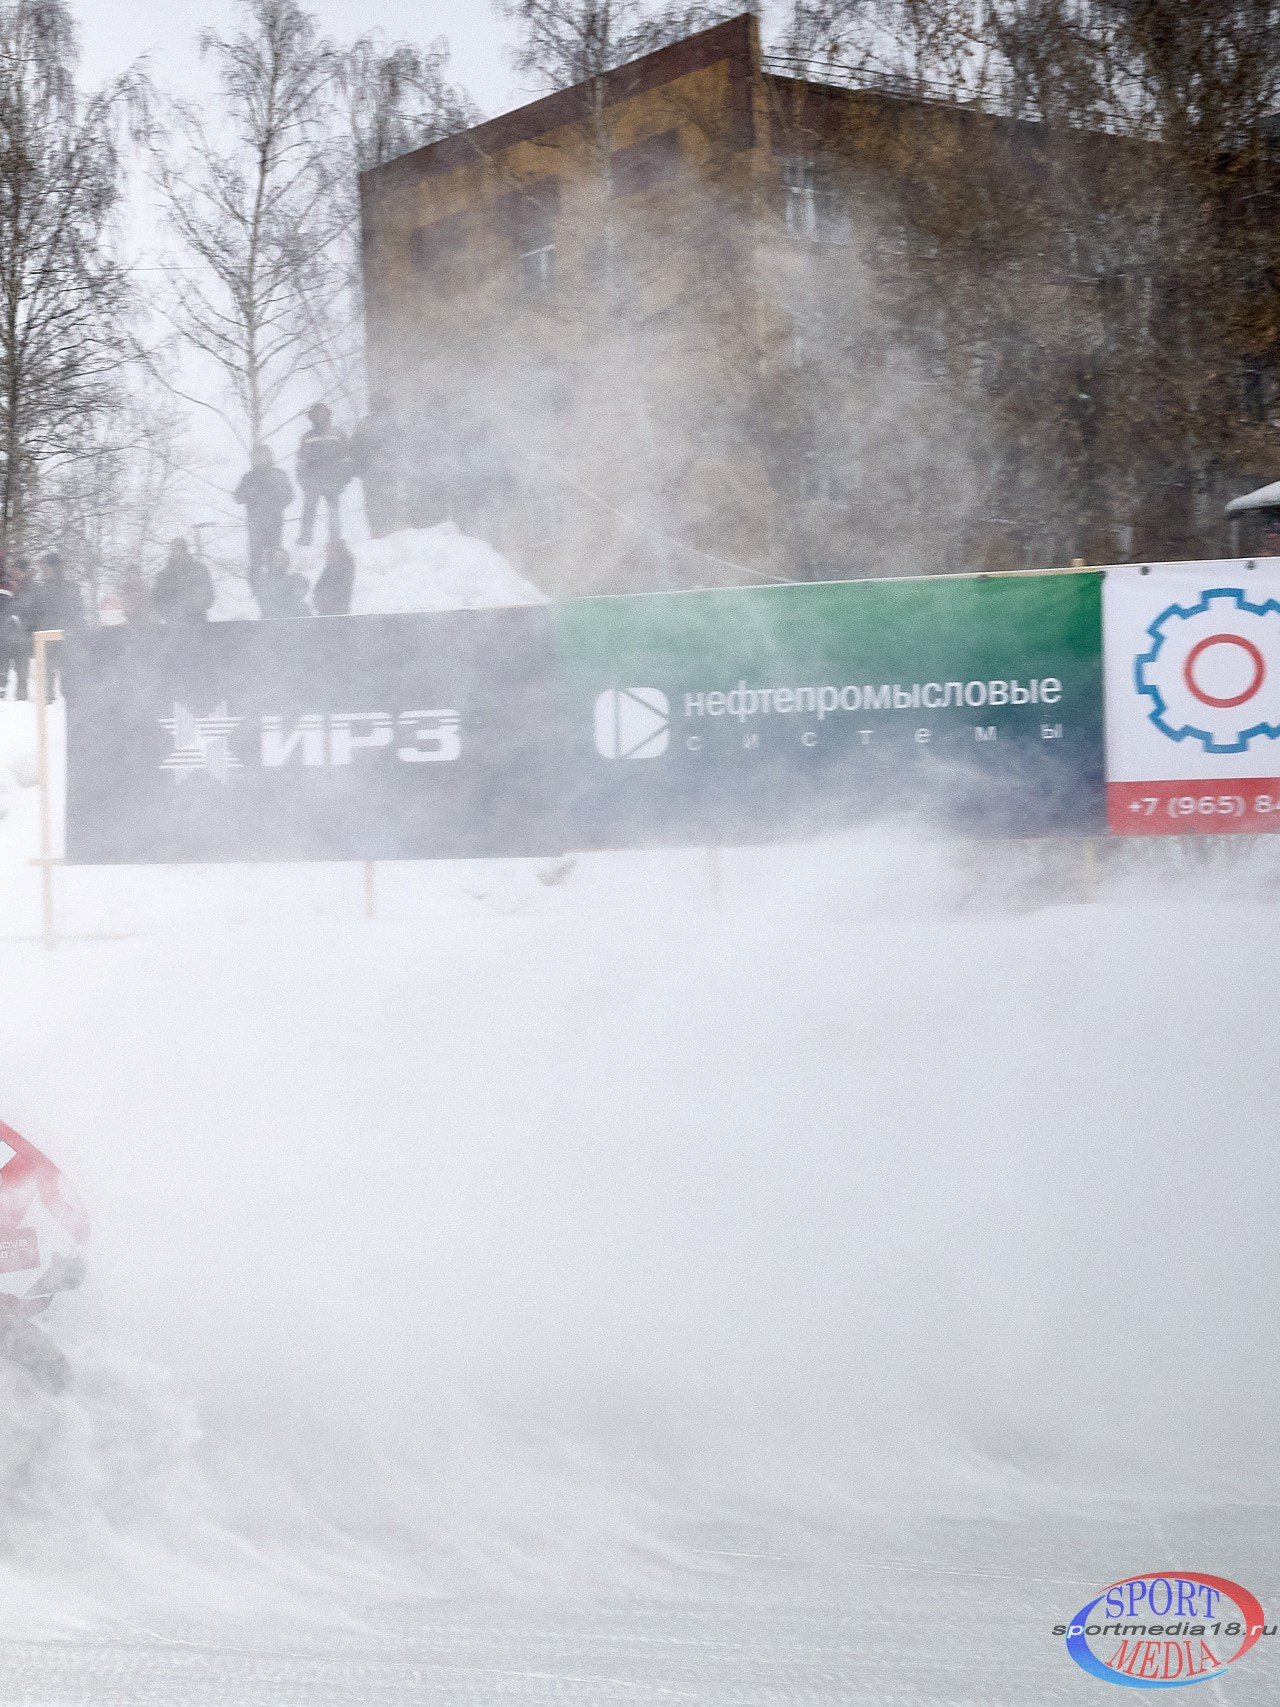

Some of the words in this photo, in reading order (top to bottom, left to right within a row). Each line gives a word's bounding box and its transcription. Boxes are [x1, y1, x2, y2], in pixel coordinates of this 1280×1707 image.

[684, 677, 1062, 723] нефтепромысловые
[261, 708, 462, 767] ИРЗ
[1128, 797, 1160, 816] +7
[1168, 795, 1245, 818] (965)
